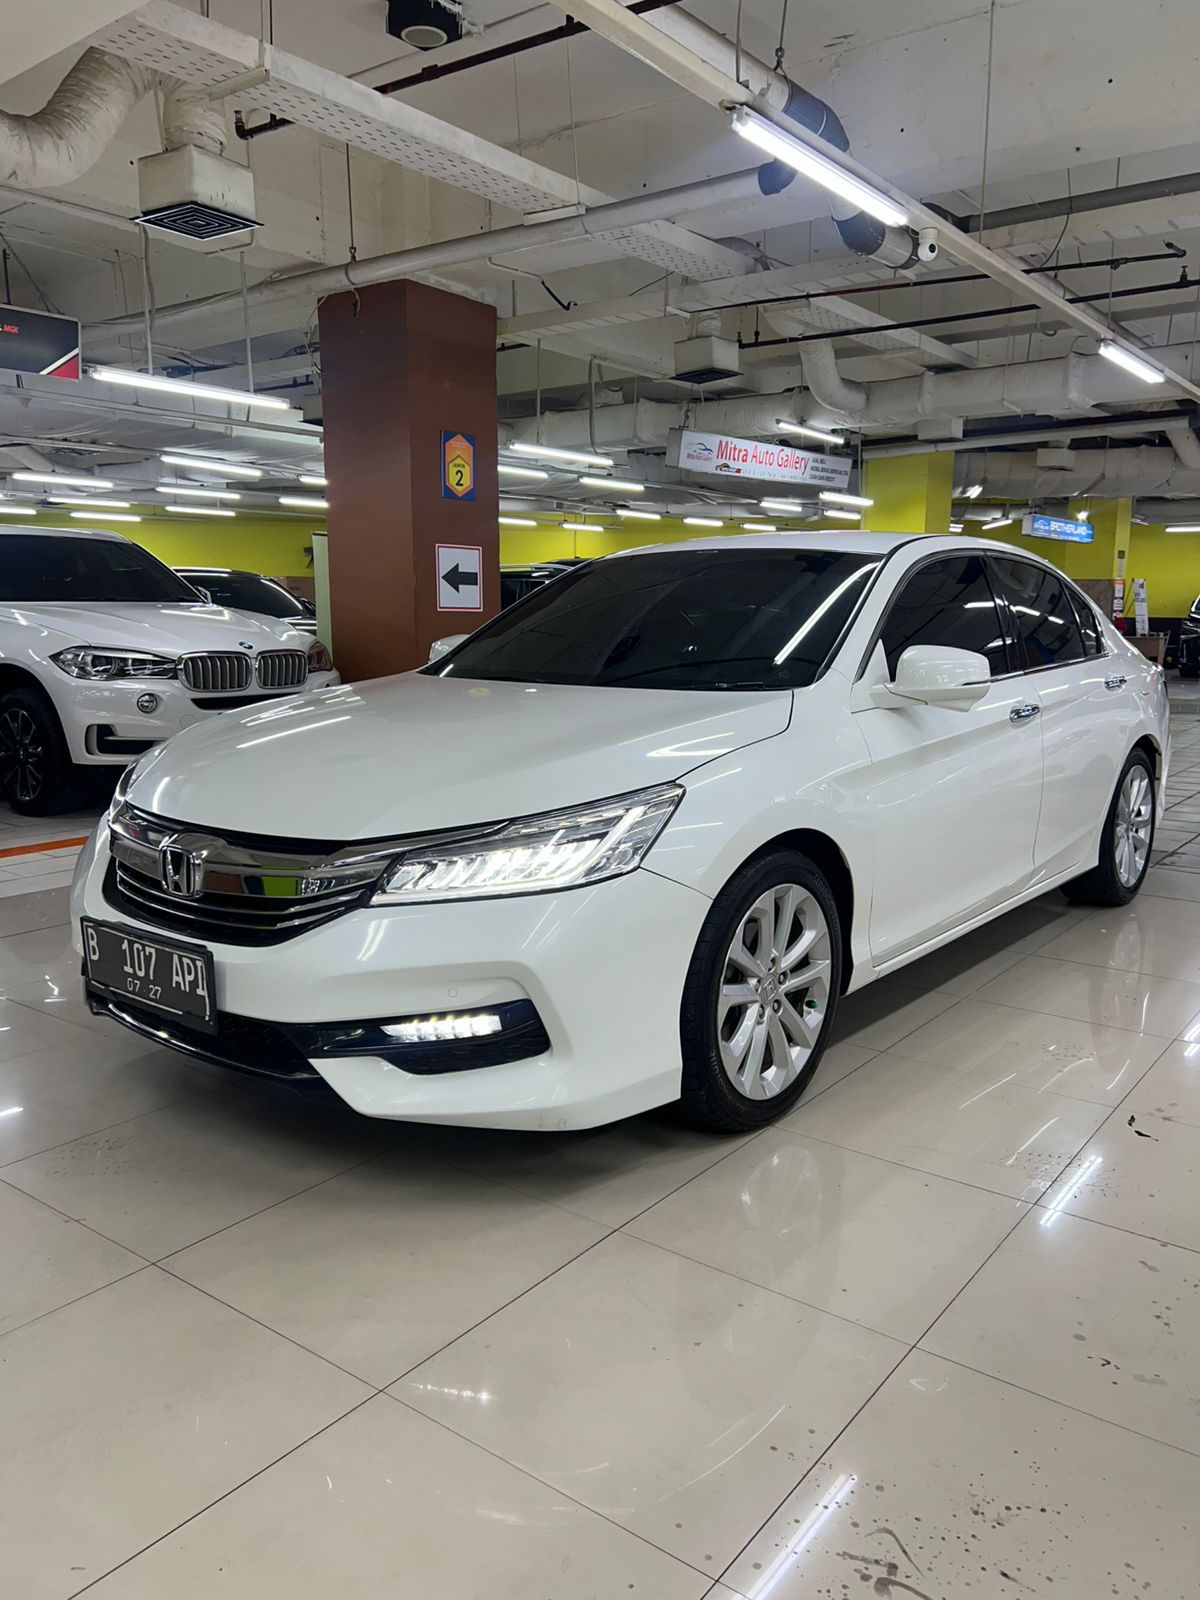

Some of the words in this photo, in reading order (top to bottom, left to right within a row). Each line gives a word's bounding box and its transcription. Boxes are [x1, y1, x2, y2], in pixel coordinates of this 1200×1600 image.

[716, 440, 749, 463] Mitra
[751, 445, 775, 466] Auto
[777, 448, 809, 475] Gallery
[455, 469, 464, 487] 2
[87, 927, 100, 961] B
[121, 939, 156, 980] 107
[172, 953, 206, 996] API
